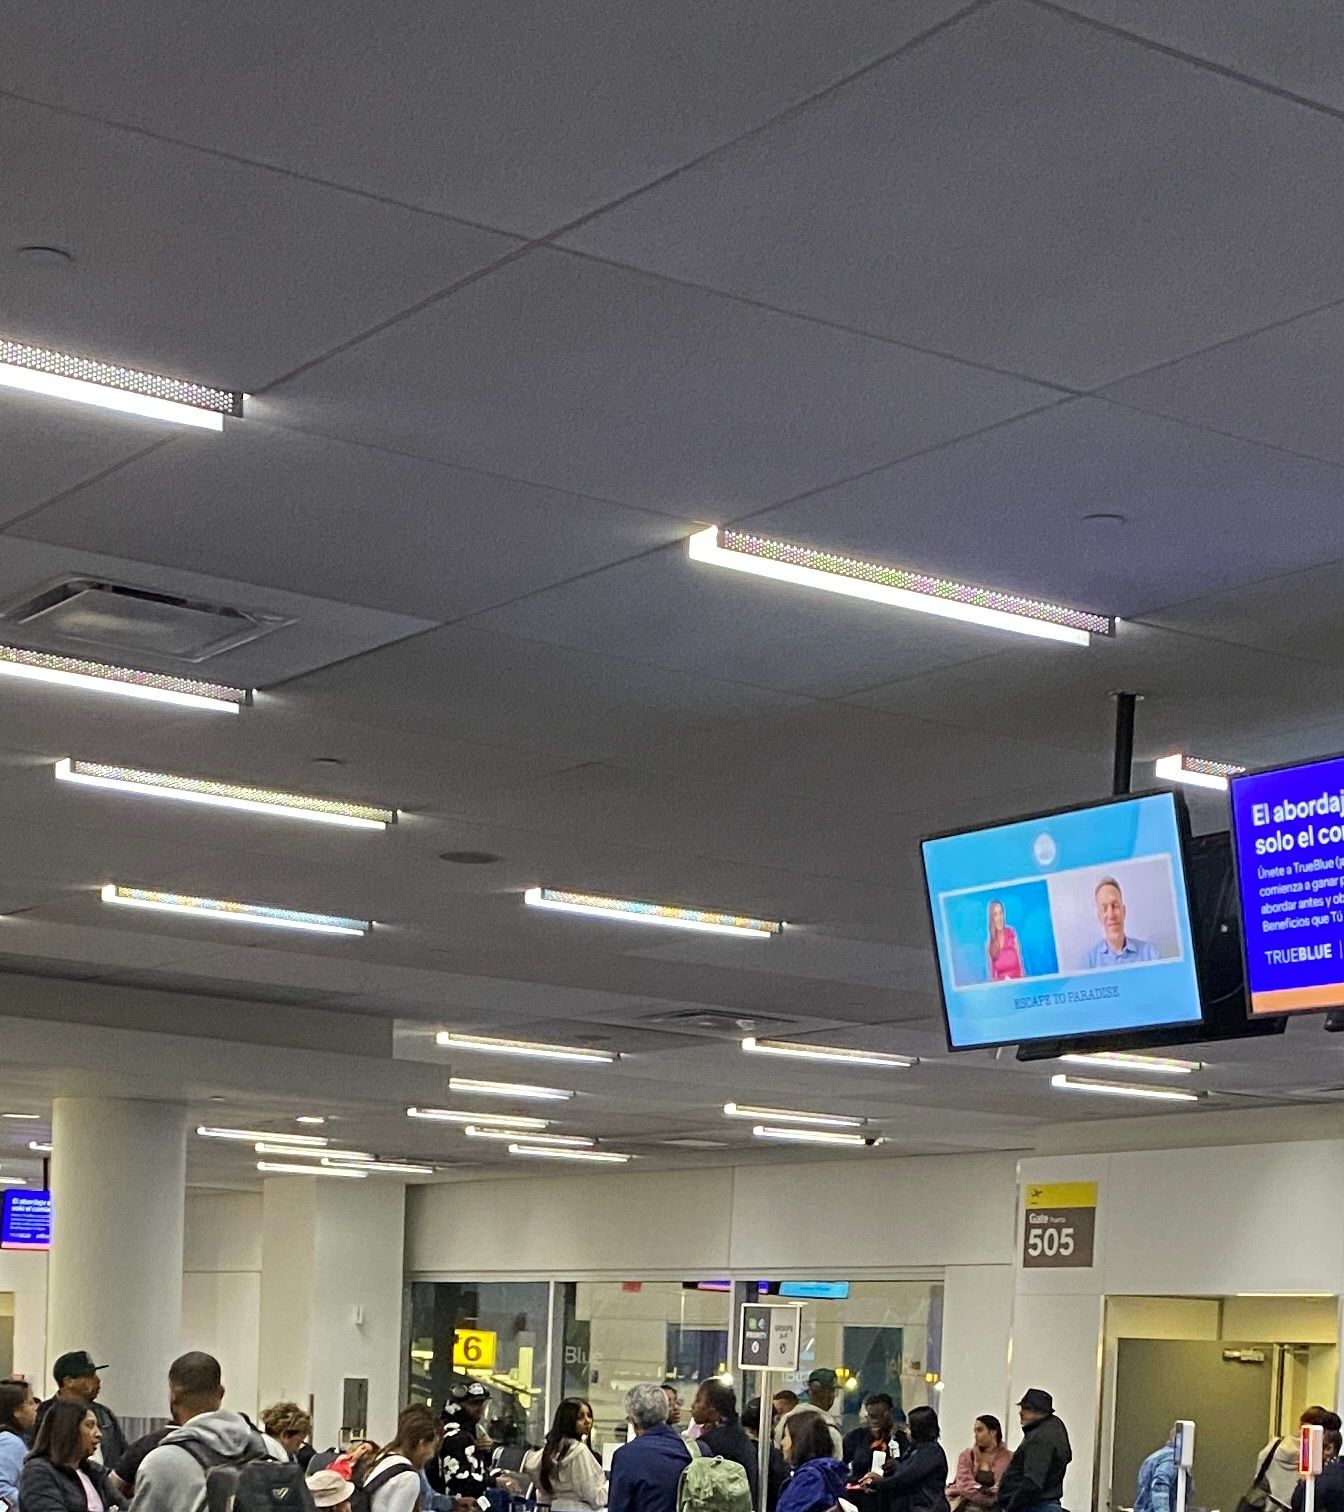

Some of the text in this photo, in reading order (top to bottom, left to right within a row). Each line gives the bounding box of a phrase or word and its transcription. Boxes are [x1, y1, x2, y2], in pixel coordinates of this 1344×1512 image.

[1252, 803, 1270, 826] El
[1255, 830, 1295, 855] solo
[1297, 825, 1314, 848] el
[1257, 865, 1285, 879] Únete
[1286, 867, 1293, 875] a
[1293, 859, 1334, 873] TrueBlue
[1259, 882, 1303, 897] comienza
[1304, 881, 1311, 891] a
[1311, 877, 1338, 892] ganar
[1261, 900, 1297, 914] abordar
[1298, 897, 1324, 910] antes
[1325, 896, 1331, 908] y
[1262, 917, 1310, 932] Beneficios
[1311, 914, 1329, 927] que
[1330, 910, 1344, 923] Tú
[1264, 943, 1333, 965] TRUEBLUE
[1014, 986, 1119, 1009] ESCAPE TO PARADISE
[1029, 1213, 1049, 1223] Gate
[1028, 1228, 1075, 1257] 505
